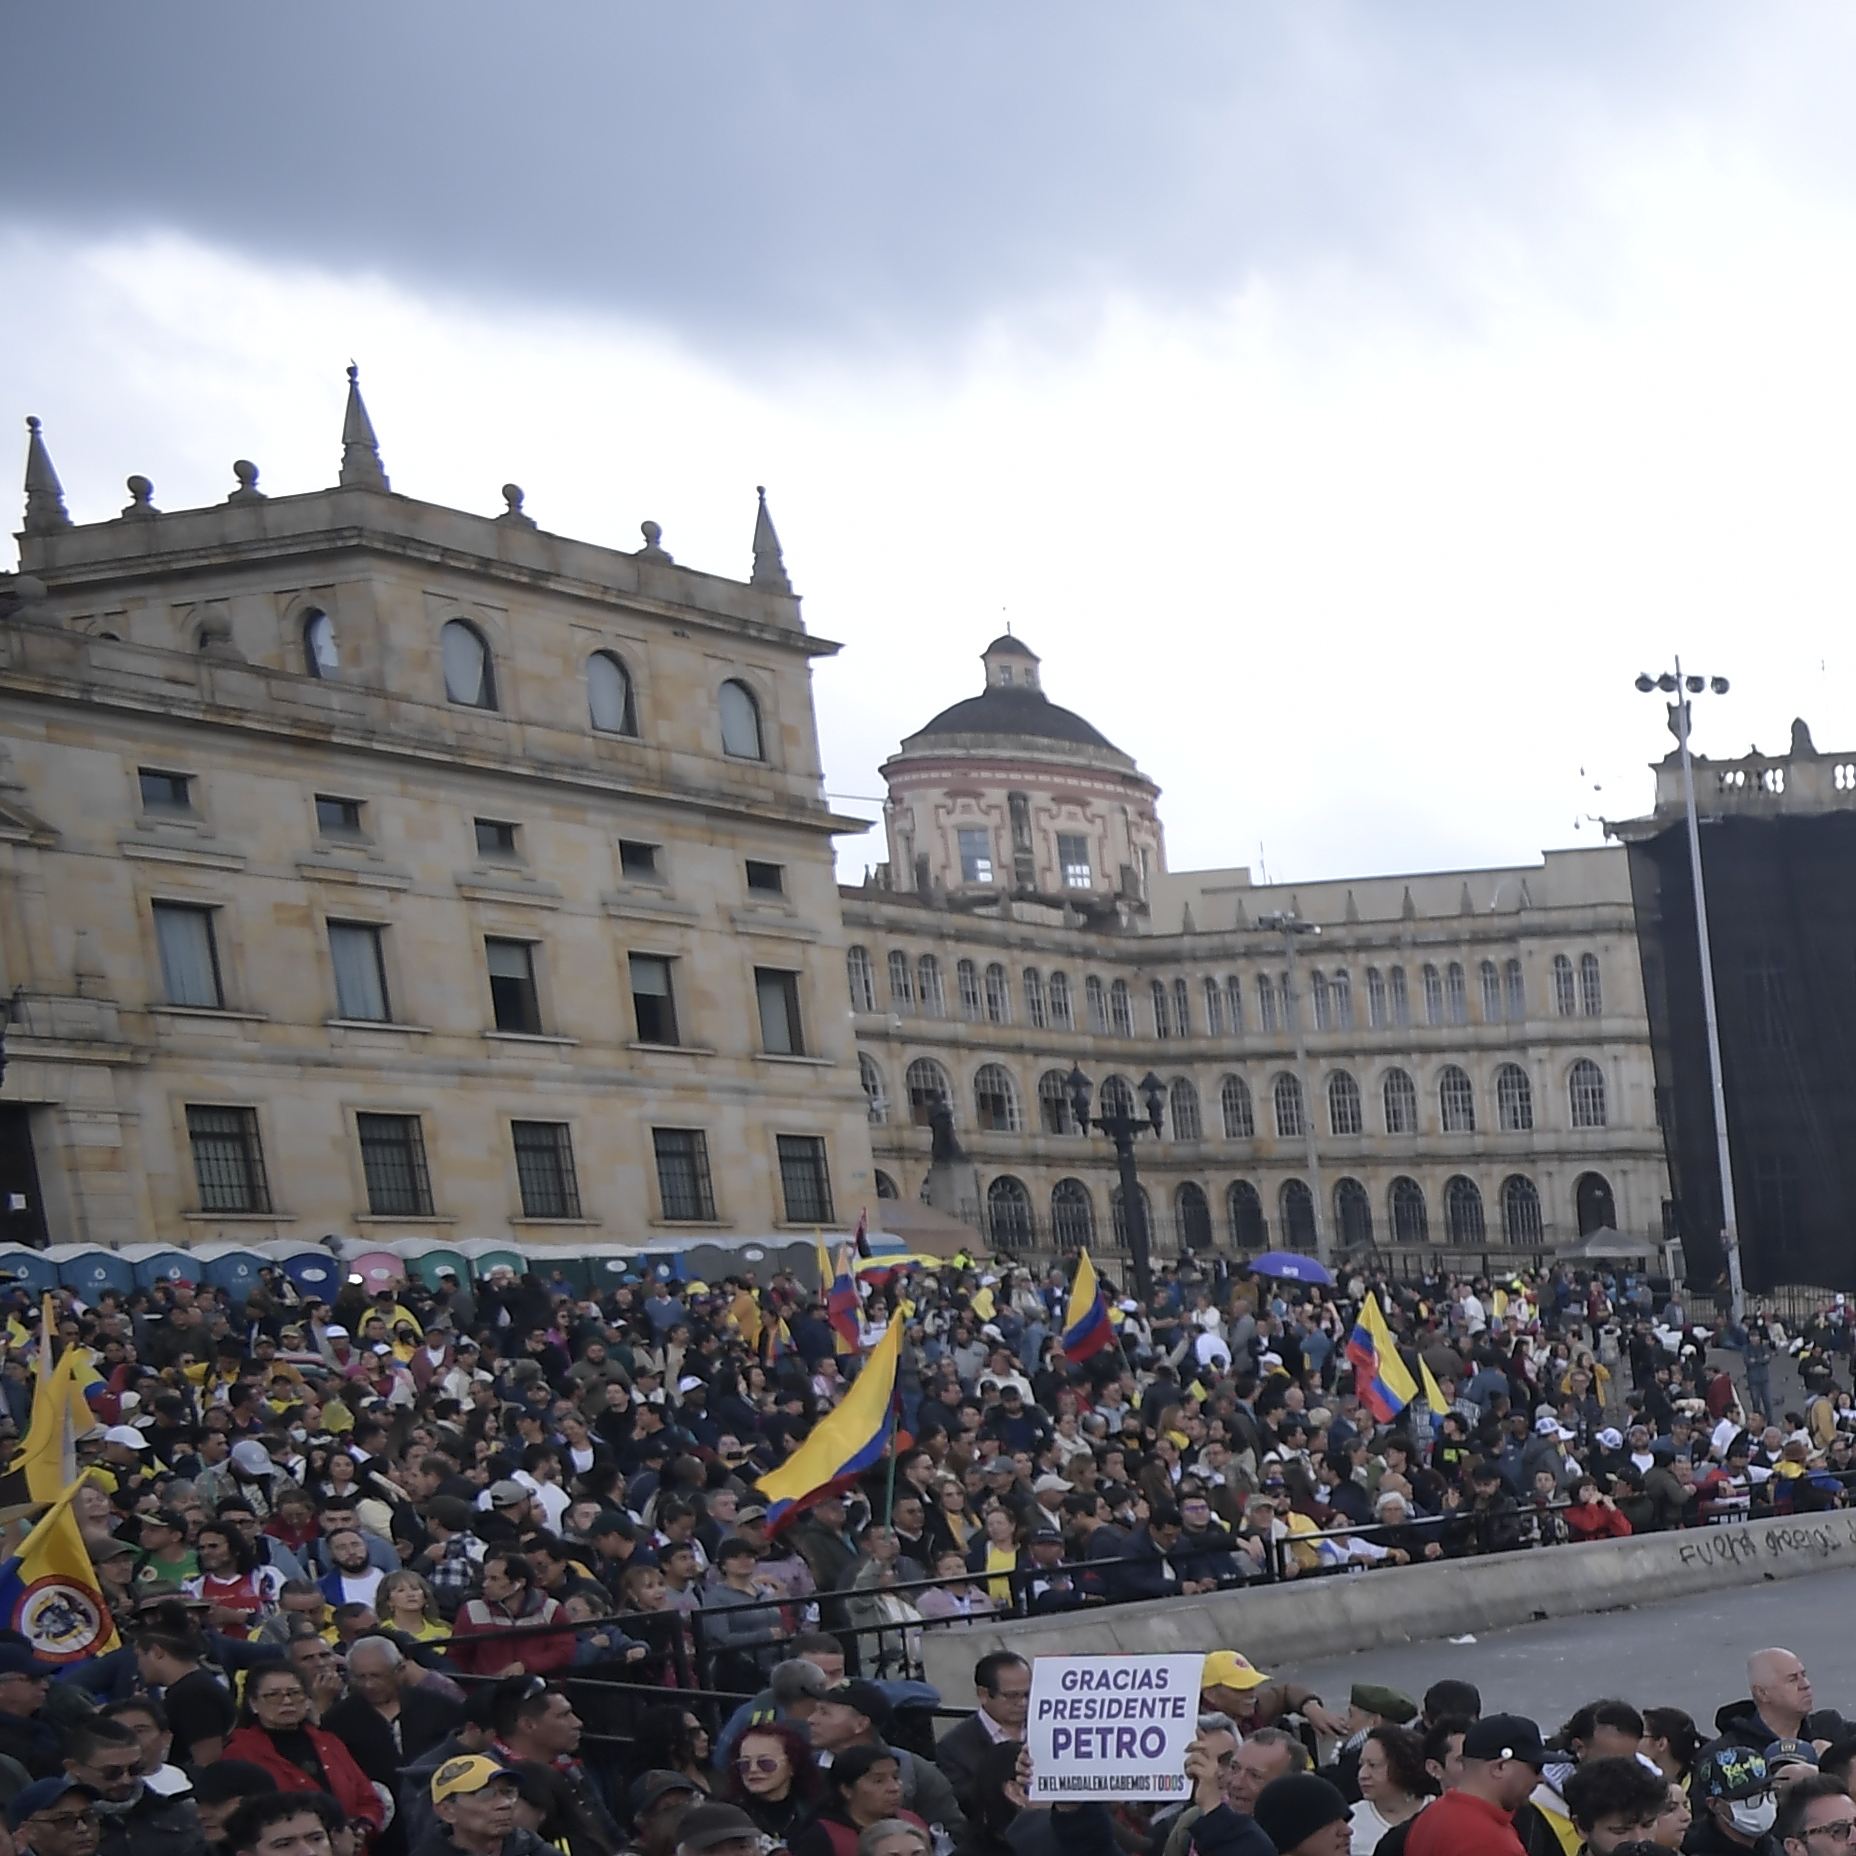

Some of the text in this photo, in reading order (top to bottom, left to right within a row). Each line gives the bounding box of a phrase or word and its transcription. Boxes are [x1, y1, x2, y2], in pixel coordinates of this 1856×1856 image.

[1061, 1668, 1169, 1691] GRACIAS
[1038, 1696, 1187, 1720] PRESIDENTE
[1052, 1725, 1166, 1760] PETRO
[1059, 1775, 1109, 1791] MAGDALENA
[1109, 1775, 1151, 1791] CABEMOS
[1152, 1774, 1185, 1792] TODOS
